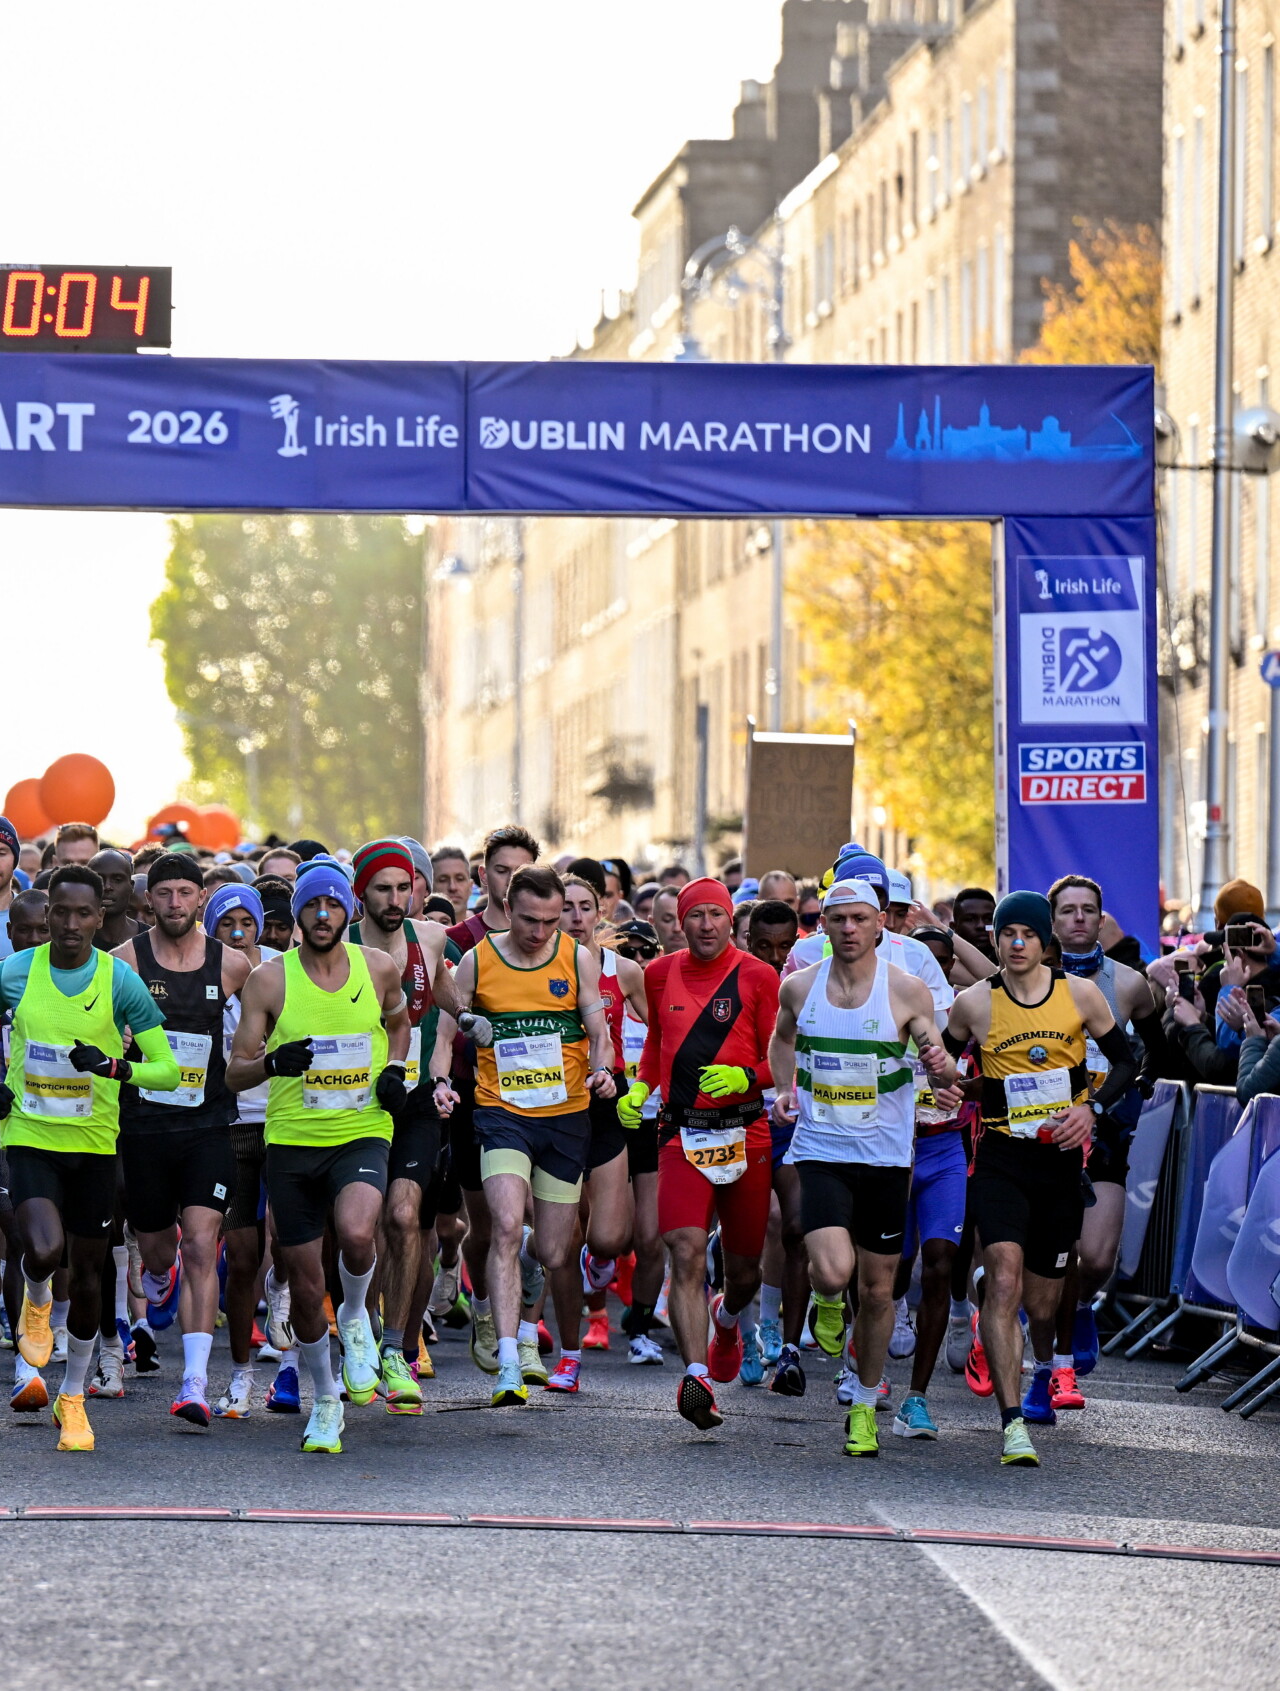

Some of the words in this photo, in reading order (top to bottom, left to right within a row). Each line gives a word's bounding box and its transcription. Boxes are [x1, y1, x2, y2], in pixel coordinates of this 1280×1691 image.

[4, 272, 149, 338] 0:04
[128, 409, 229, 446] 2026
[315, 415, 391, 447] Irish
[397, 417, 459, 448] Life
[639, 420, 871, 455] MARATHON
[1055, 578, 1087, 594] Irish
[1092, 578, 1122, 595] Life
[1041, 627, 1055, 693] DUBLIN
[1043, 696, 1120, 707] MARATHON
[1027, 747, 1137, 770] SPORTS
[1028, 777, 1137, 800] DIRECT
[413, 963, 425, 991] ROAD
[993, 1031, 1065, 1053] BOHERMEEN
[25, 1080, 65, 1091] KIPROTICH
[180, 1072, 204, 1083] LEY
[306, 1073, 369, 1085] LACHGAR
[501, 1071, 561, 1087] O'REGAN
[814, 1088, 875, 1100] MAUNSELL
[694, 1145, 736, 1165] 2735
